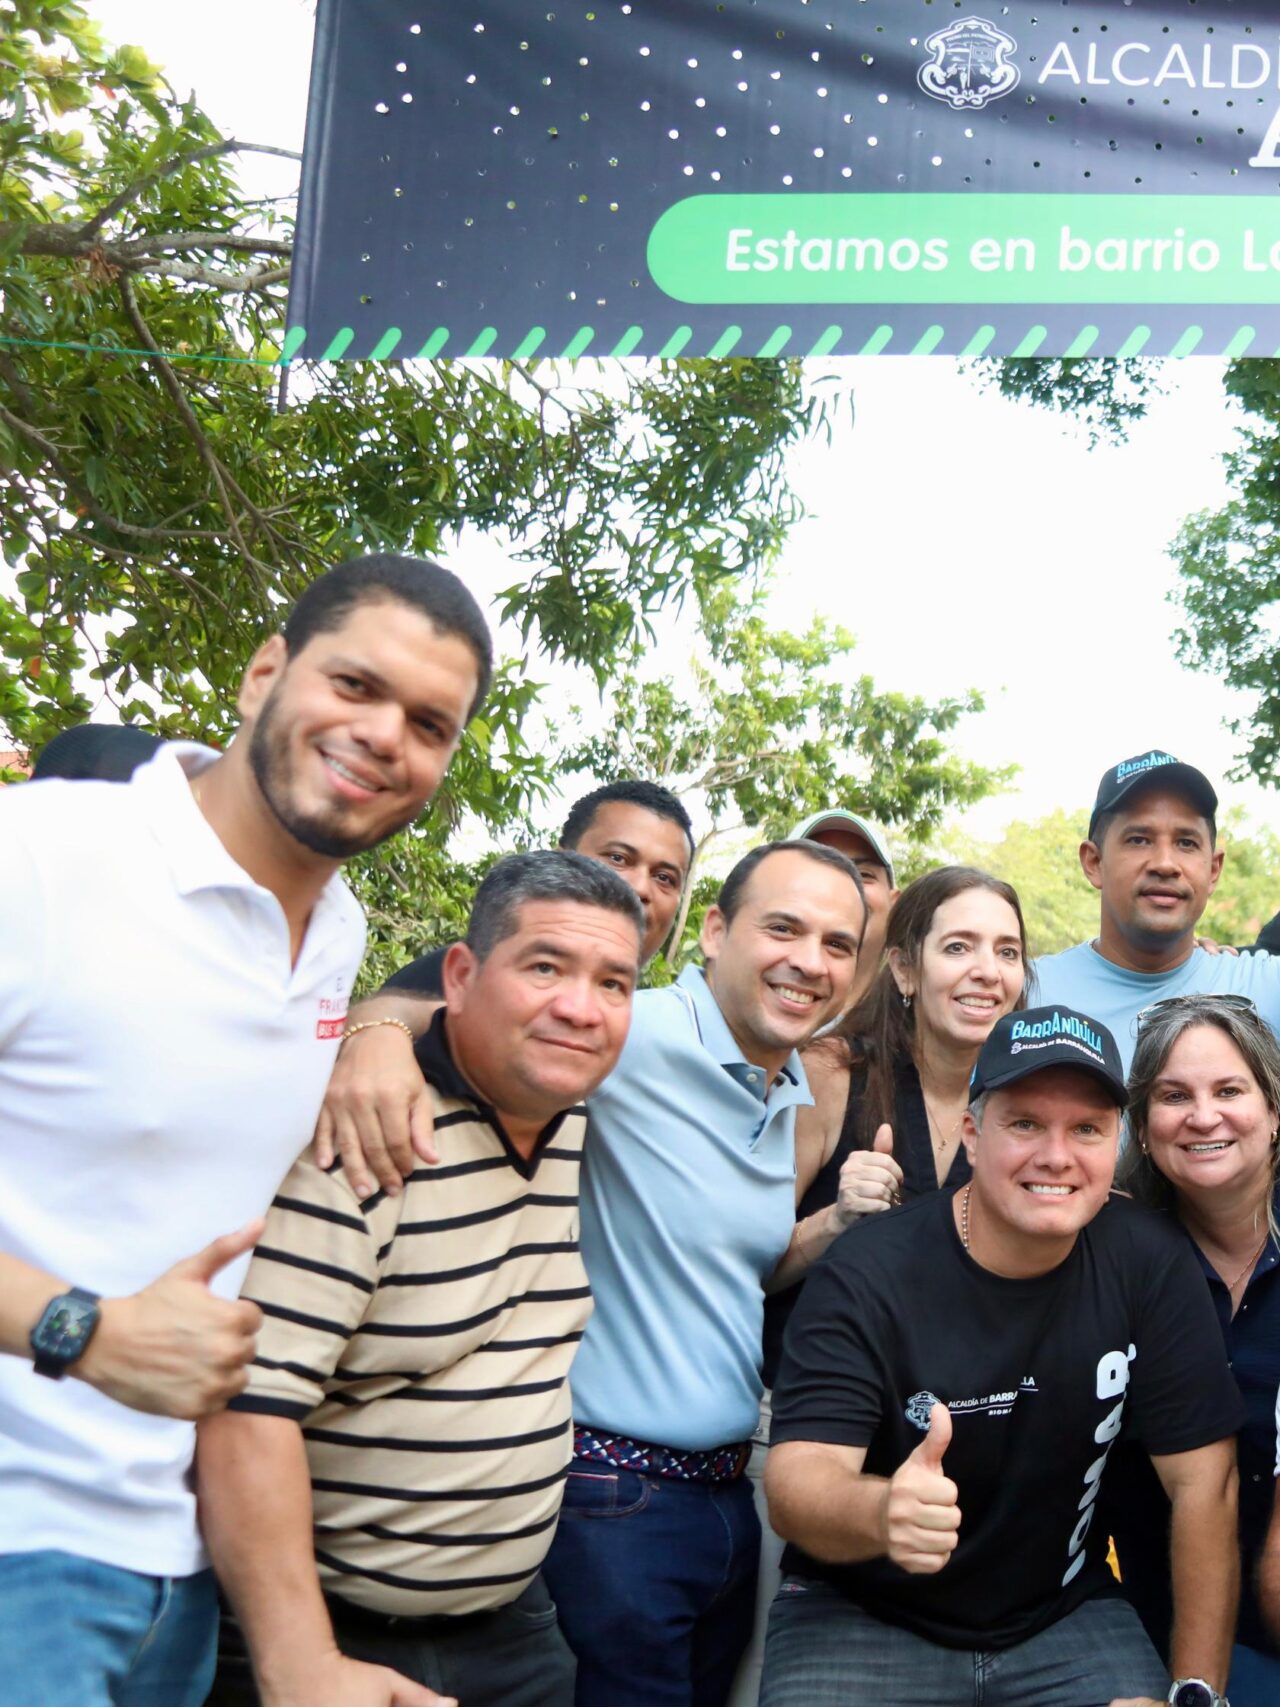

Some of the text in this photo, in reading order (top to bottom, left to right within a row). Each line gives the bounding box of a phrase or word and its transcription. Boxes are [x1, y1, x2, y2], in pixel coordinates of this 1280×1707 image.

[725, 228, 948, 272] Estamos
[969, 239, 1035, 271] en
[1058, 227, 1220, 272] barrio
[1011, 1011, 1102, 1054] BARRANQUILLA
